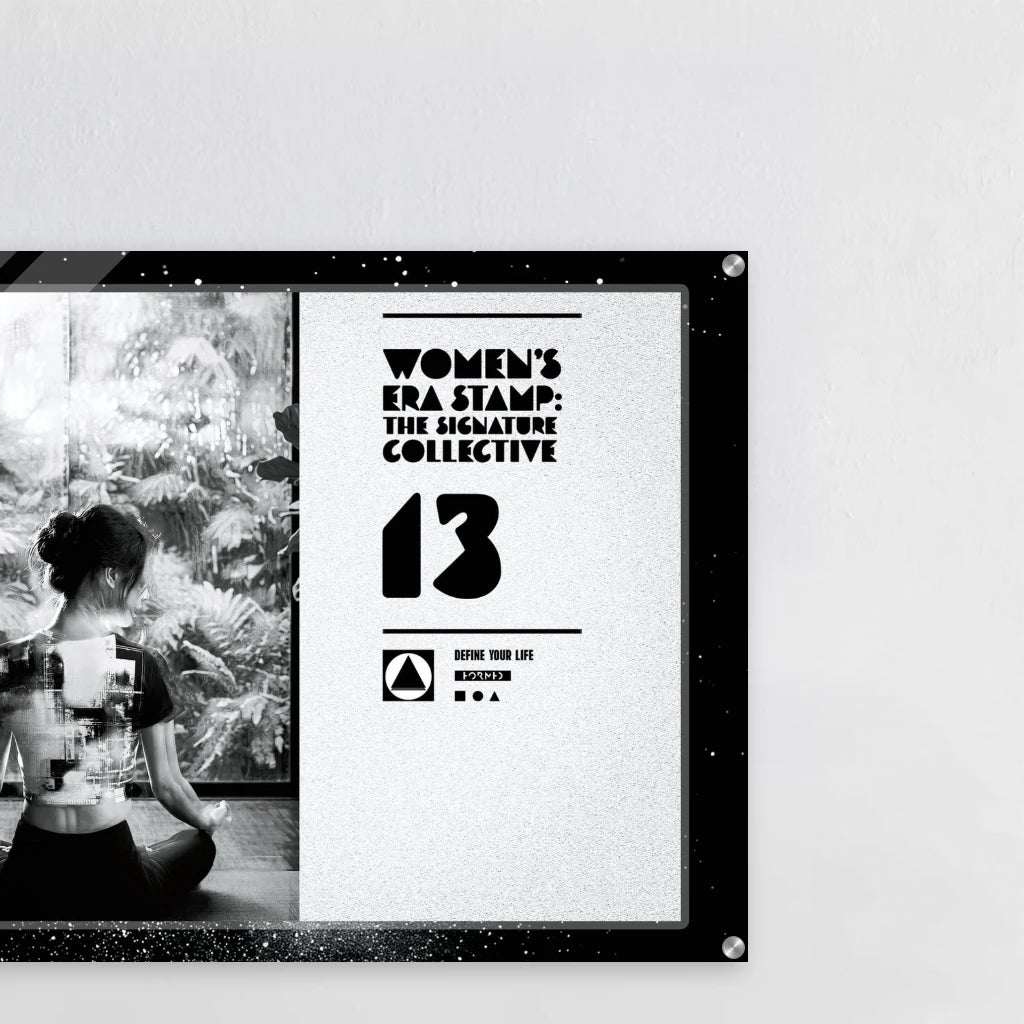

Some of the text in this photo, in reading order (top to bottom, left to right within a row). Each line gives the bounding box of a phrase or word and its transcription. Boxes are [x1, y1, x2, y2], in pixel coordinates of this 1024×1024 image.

[382, 348, 562, 380] WOMEN'S
[382, 385, 563, 412] ERA STAMP:
[382, 416, 558, 435] THE SIGNATURE
[382, 439, 557, 463] COLLECTIVE
[382, 492, 502, 600] 13
[454, 649, 534, 661] DEFINE YOUR LIFE
